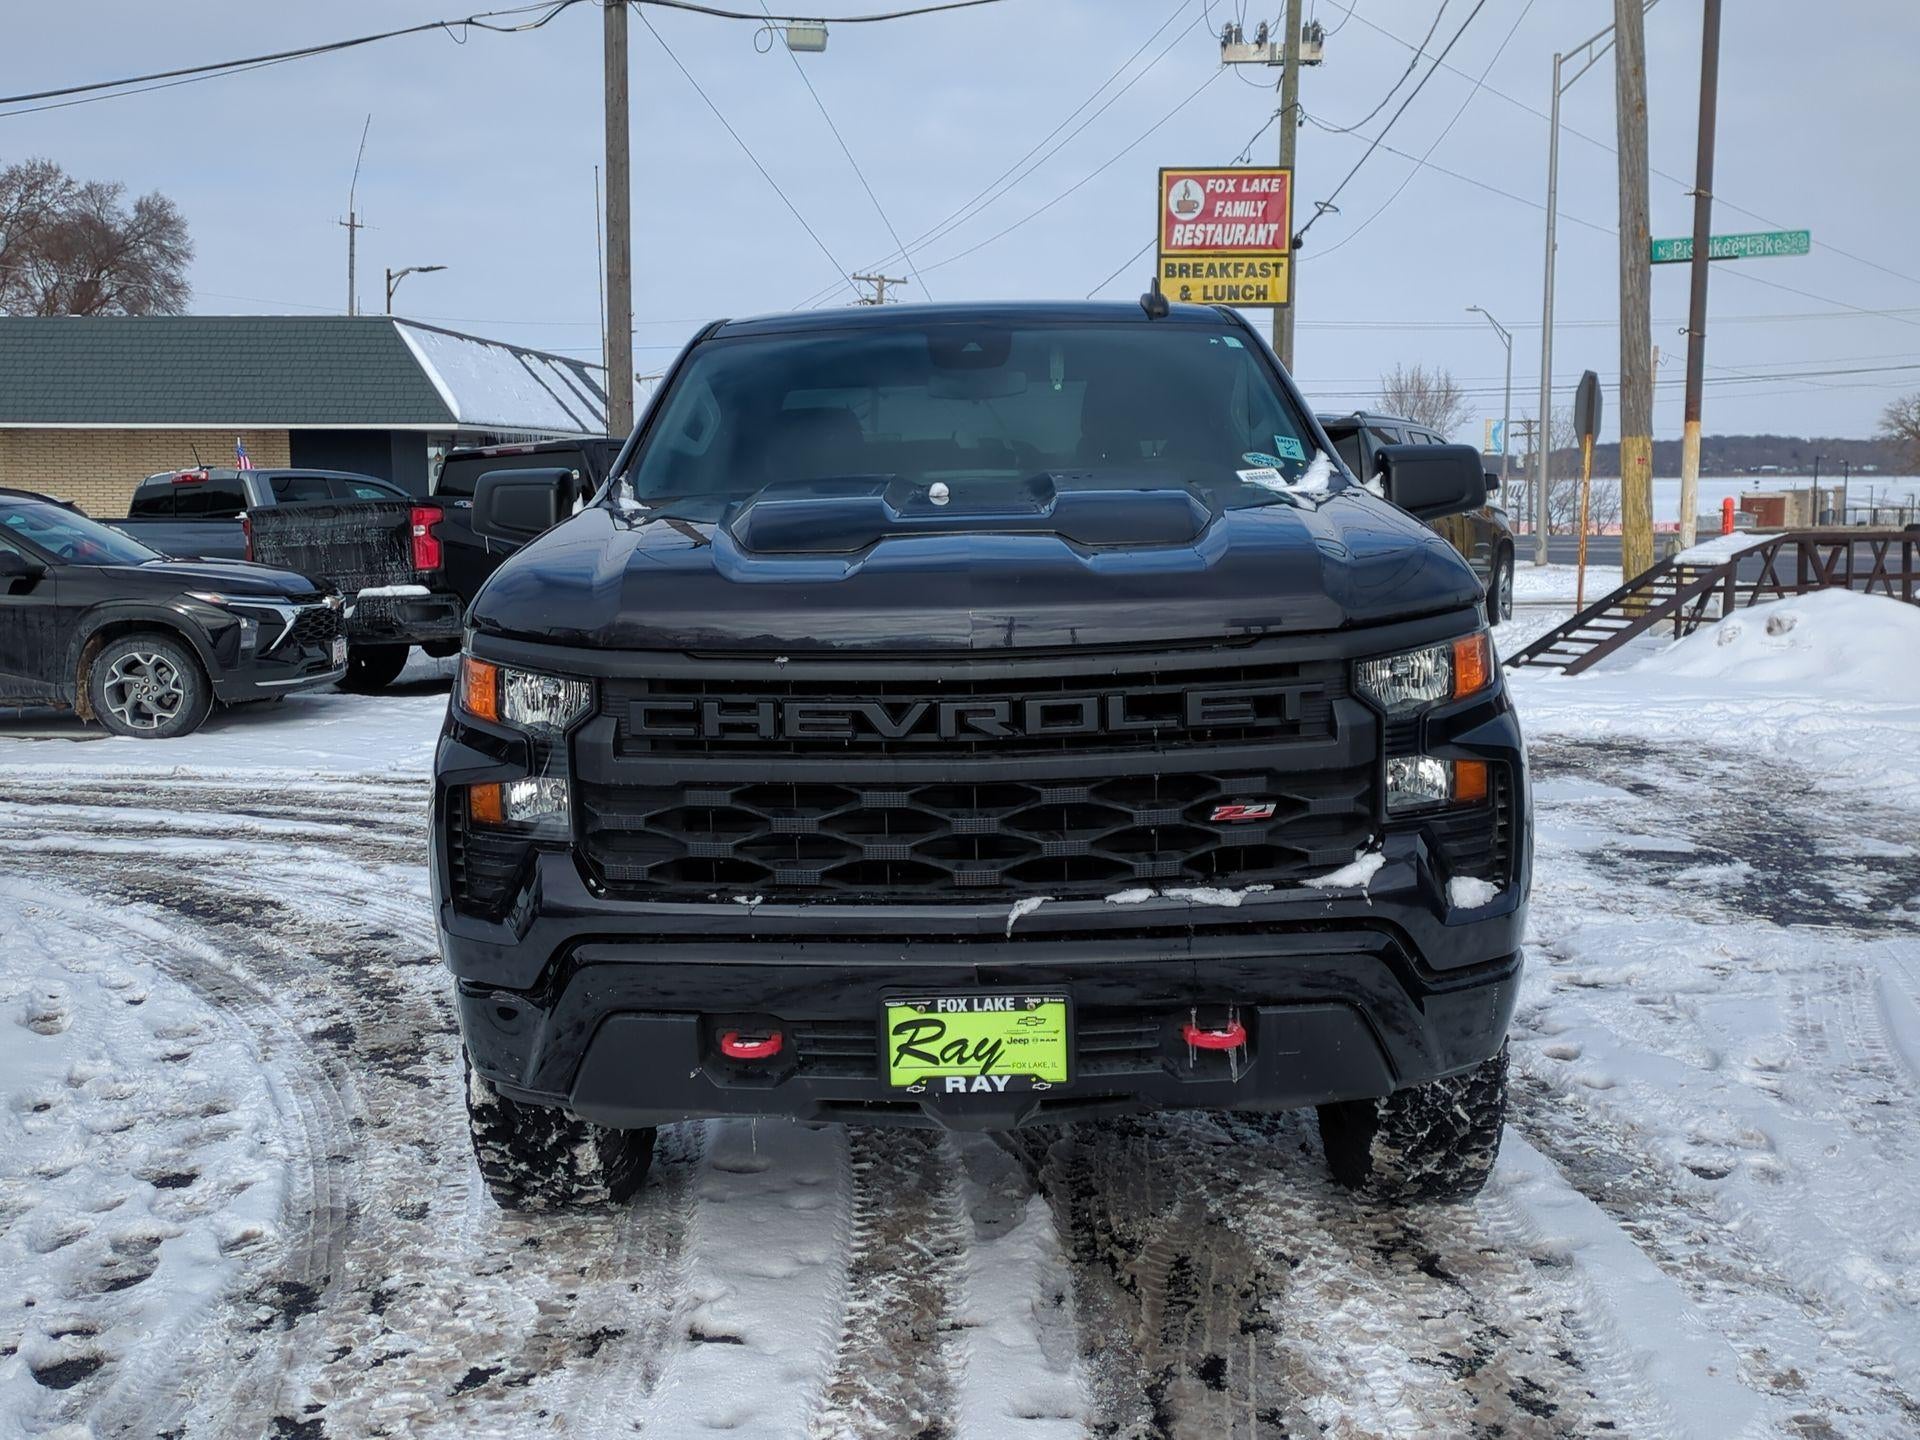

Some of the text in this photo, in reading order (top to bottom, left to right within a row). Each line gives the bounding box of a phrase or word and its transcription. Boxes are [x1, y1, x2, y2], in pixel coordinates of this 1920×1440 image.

[1206, 178, 1281, 193] FOX LAKE
[1214, 201, 1267, 217] FAMILY
[1172, 223, 1278, 246] RESTAURANT
[1673, 240, 1738, 258] Piskee
[1746, 236, 1782, 255] Lake
[1164, 262, 1283, 279] BREAKFAST
[1179, 284, 1268, 301] & LUNCH
[630, 684, 1323, 739] CHEVROLET
[937, 997, 1015, 1012] FOX LAKE
[1024, 996, 1041, 1005] Jeep
[892, 1018, 1006, 1075] Ray
[1006, 1036, 1030, 1046] Jeep
[945, 1075, 1012, 1094] RAY
